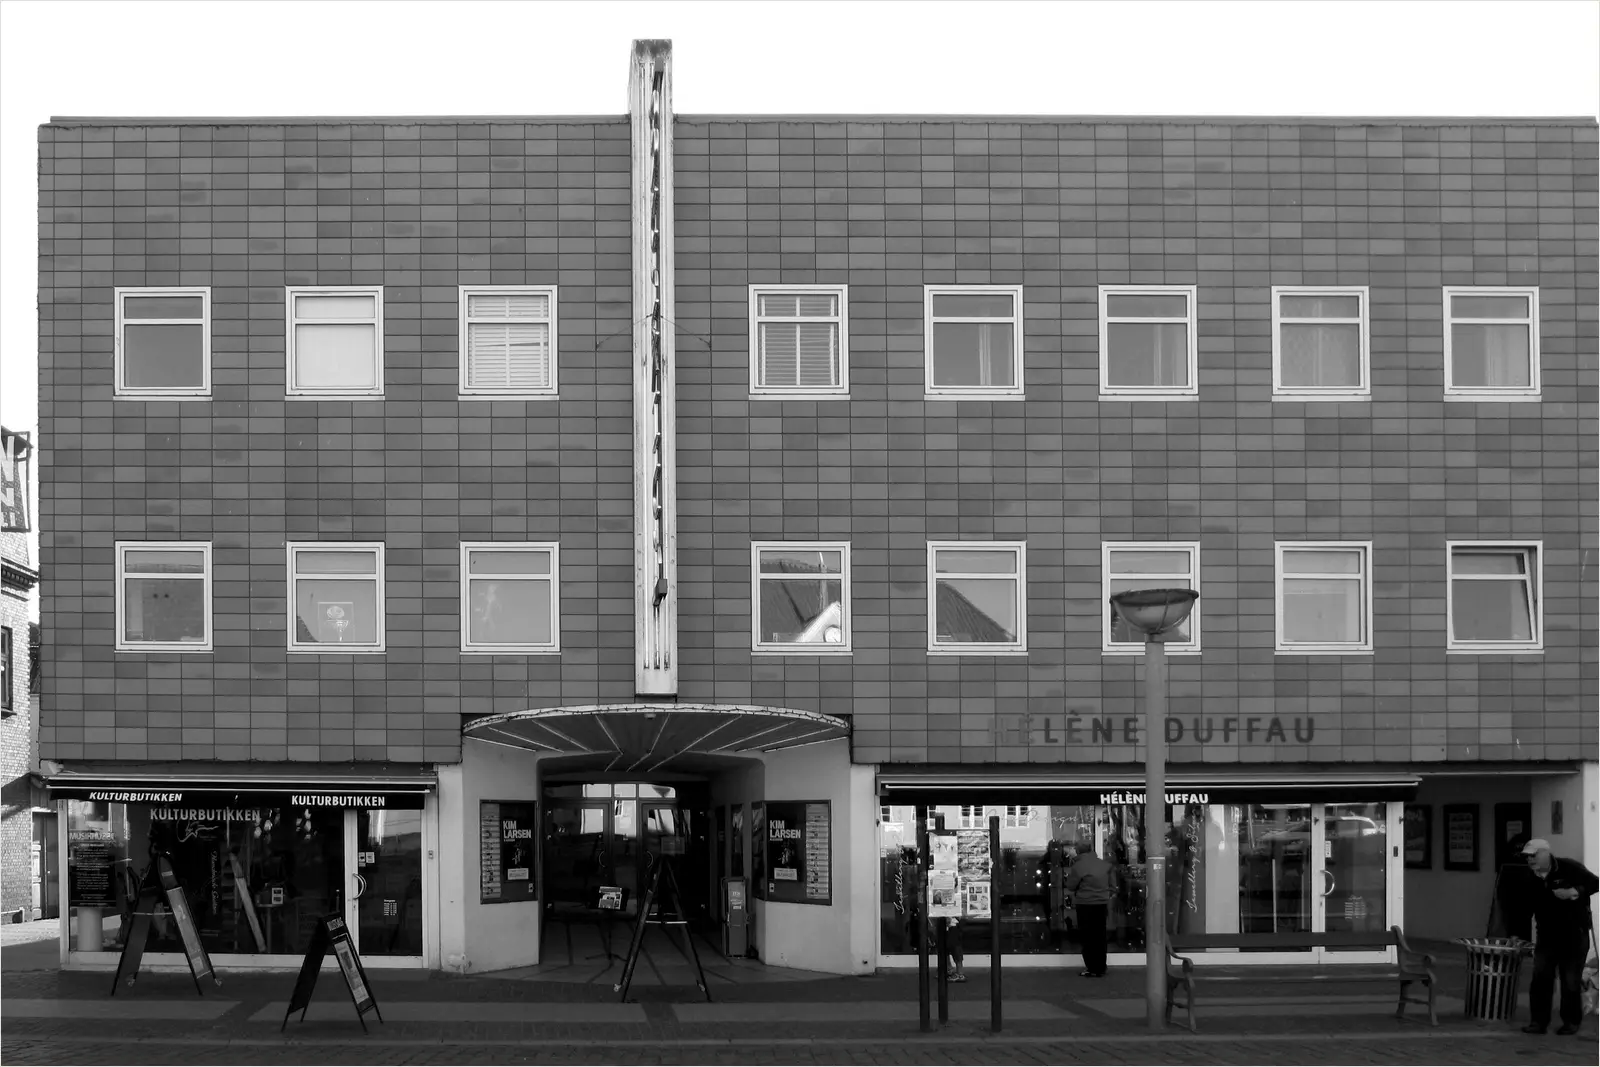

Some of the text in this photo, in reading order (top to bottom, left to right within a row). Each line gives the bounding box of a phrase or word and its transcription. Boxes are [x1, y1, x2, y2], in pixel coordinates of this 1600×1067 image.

[1164, 716, 1316, 744] DUFFAU
[89, 791, 183, 802] KULTURBUTIKKEN
[291, 794, 386, 807] KULTURBUTIKKEN
[1100, 790, 1209, 804] HÉLÈN UFFAU
[150, 808, 260, 822] KULTURBUTIKKEN
[503, 820, 517, 829] KIM
[769, 820, 785, 829] KIM
[503, 829, 532, 839] LARSEN
[769, 829, 802, 839] LARSEN
